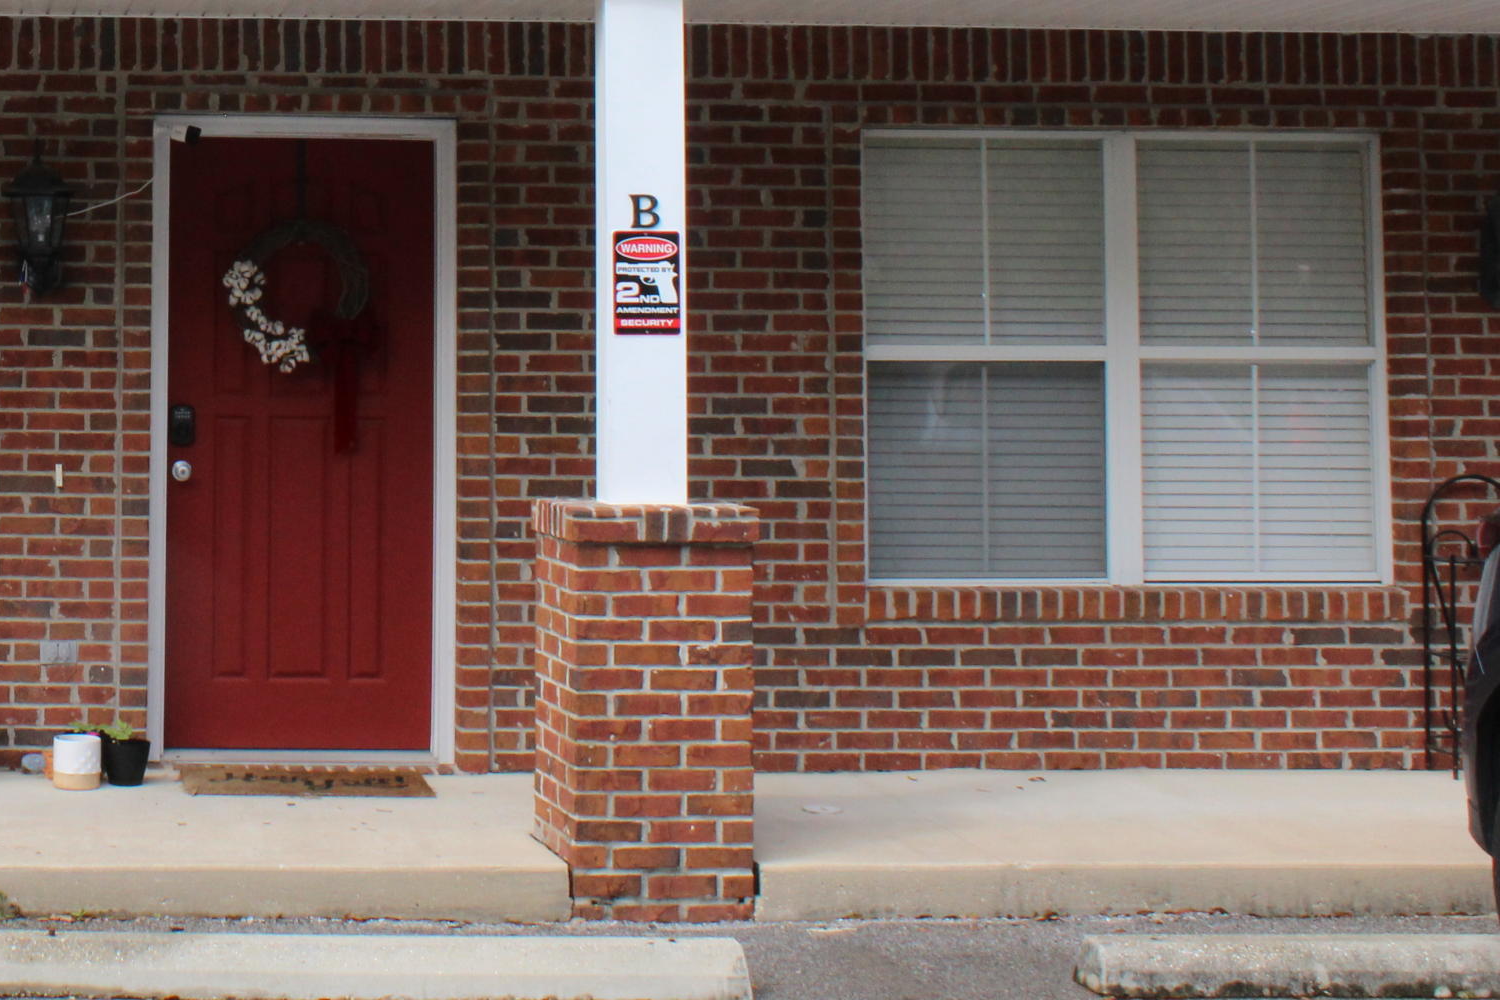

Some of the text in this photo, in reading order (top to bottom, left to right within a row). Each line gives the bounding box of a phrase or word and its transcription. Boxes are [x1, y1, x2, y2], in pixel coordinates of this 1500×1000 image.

[629, 194, 660, 228] B
[620, 243, 673, 254] WARNING
[616, 306, 679, 314] AMENDMENT
[620, 319, 674, 327] SECURITY
